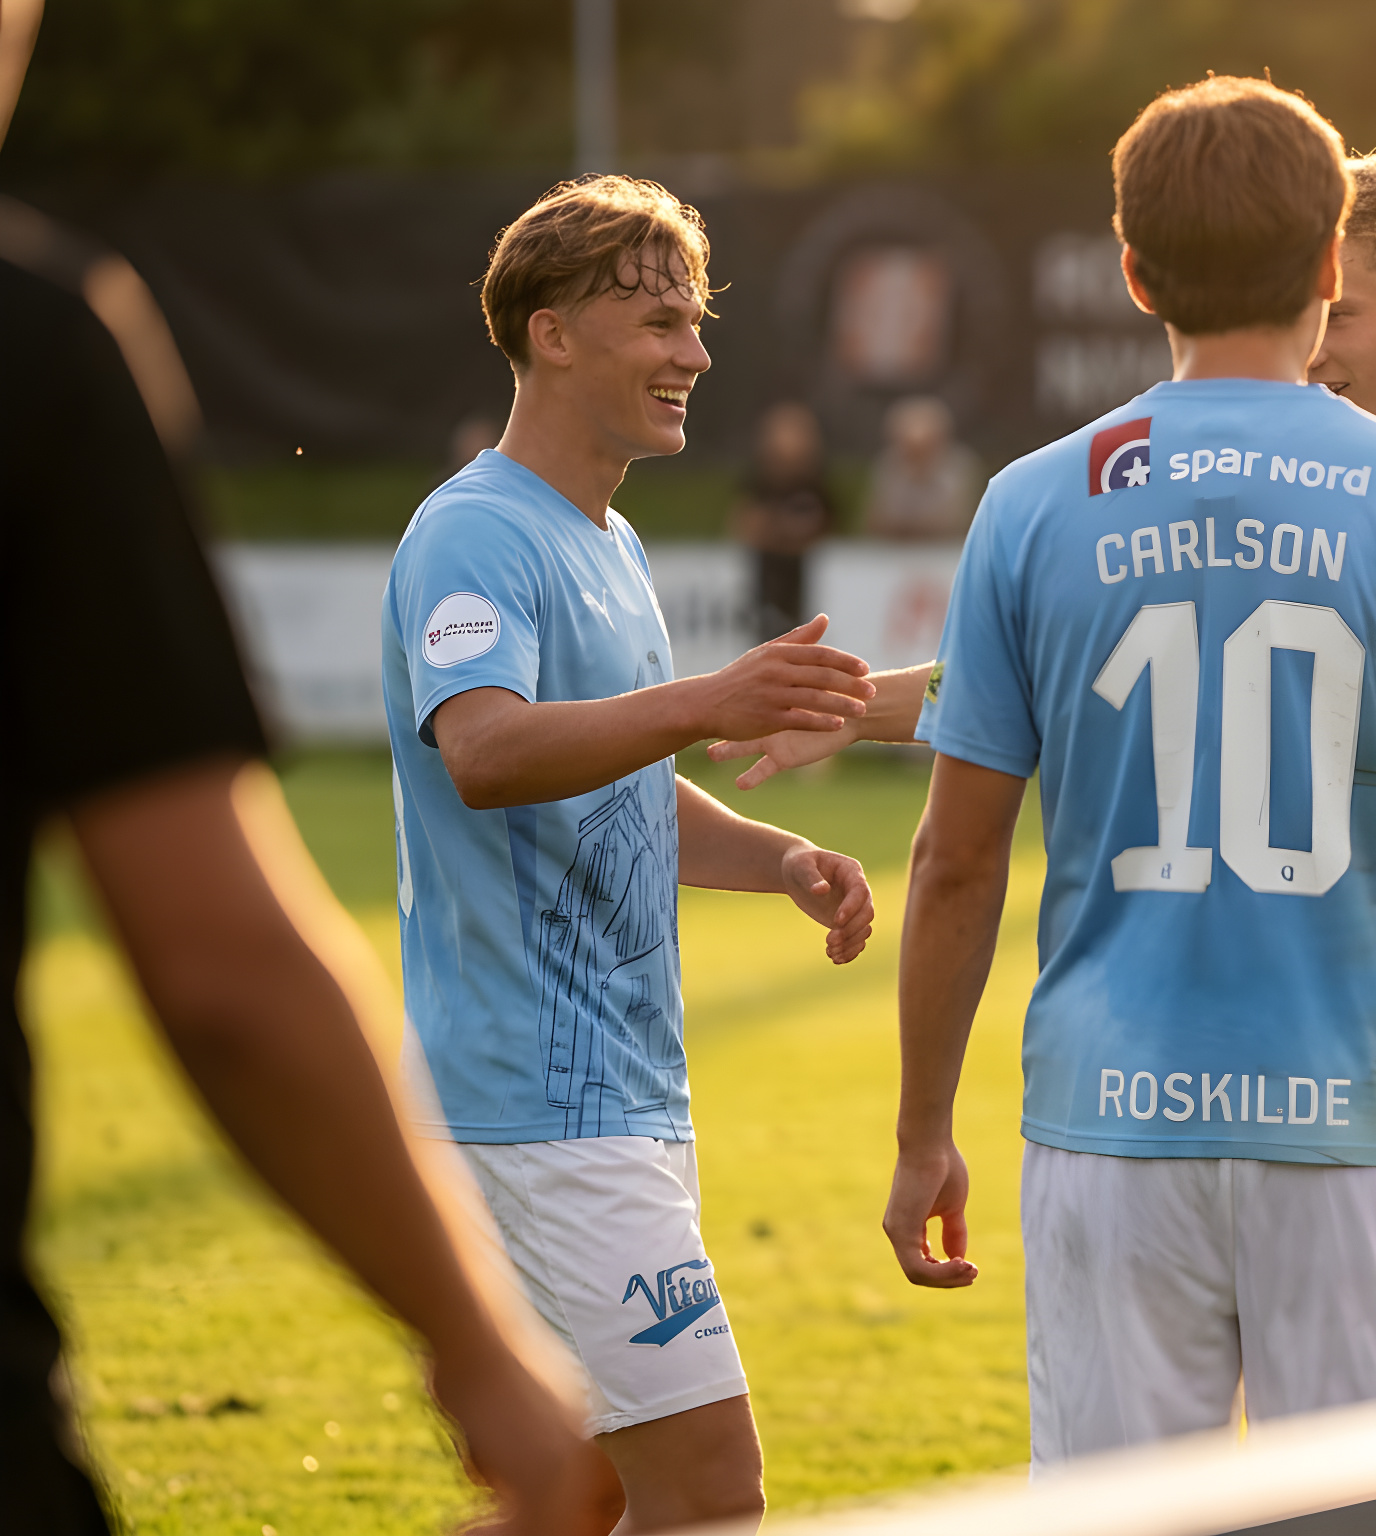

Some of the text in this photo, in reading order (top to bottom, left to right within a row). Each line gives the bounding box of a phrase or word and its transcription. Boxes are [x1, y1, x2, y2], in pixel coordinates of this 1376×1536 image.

[1169, 448, 1262, 482] spar
[1096, 517, 1347, 584] CARLSON
[1092, 600, 1366, 897] 10
[1099, 1068, 1351, 1126] ROSKILDE
